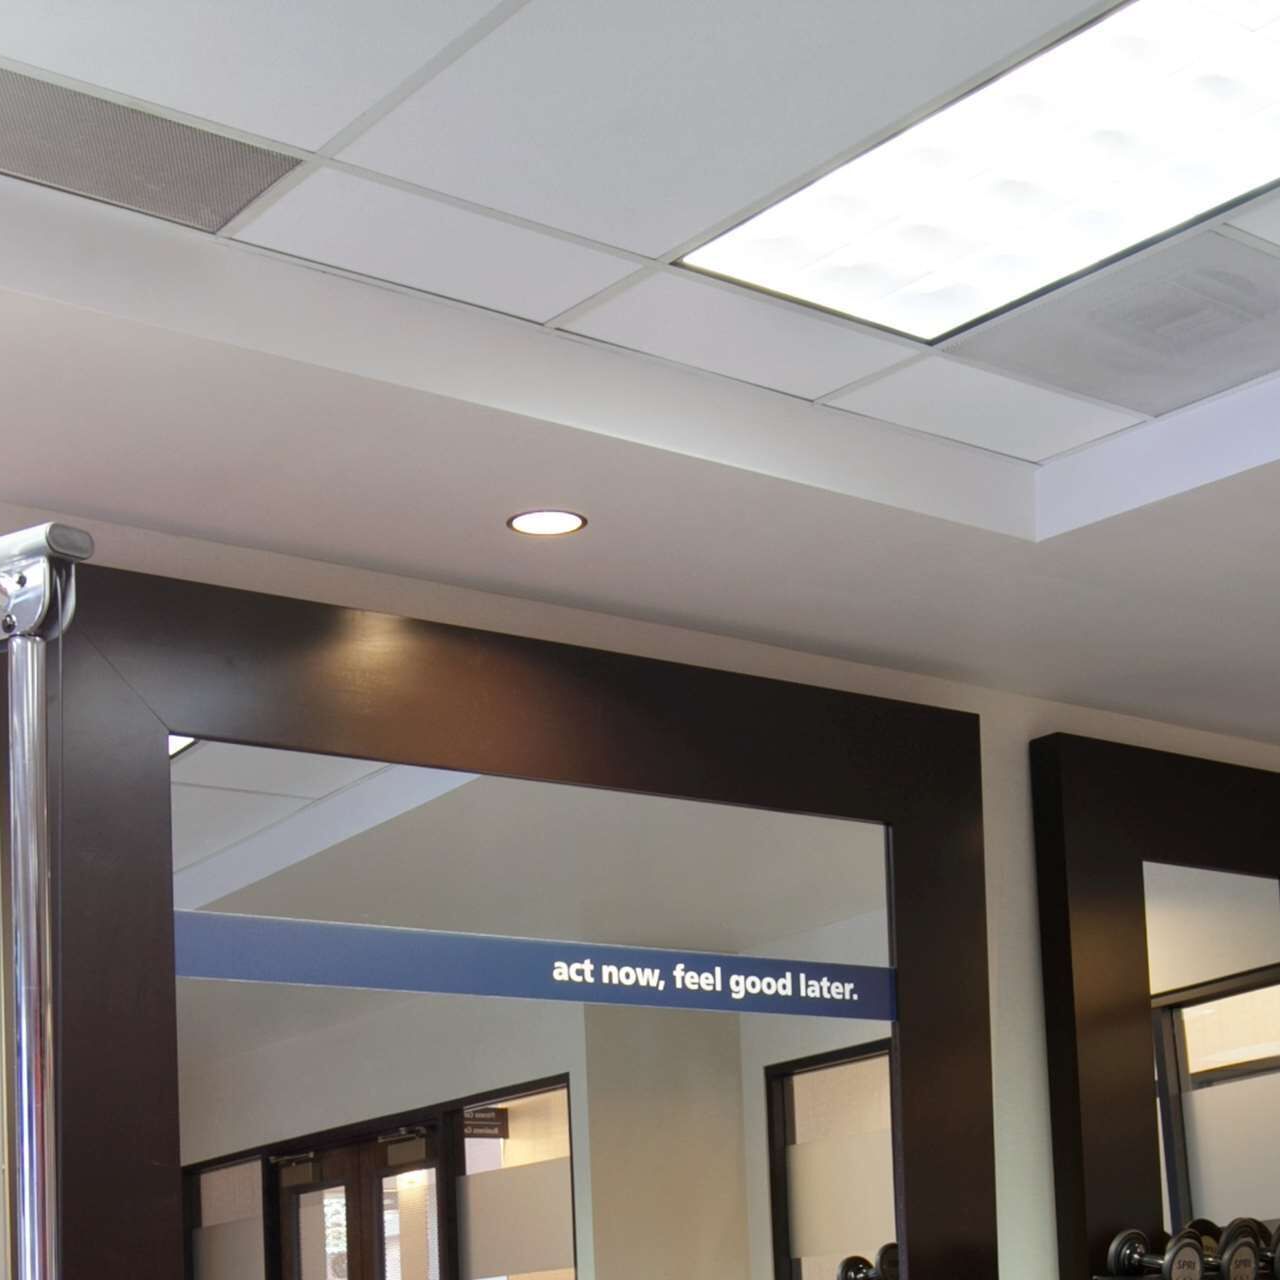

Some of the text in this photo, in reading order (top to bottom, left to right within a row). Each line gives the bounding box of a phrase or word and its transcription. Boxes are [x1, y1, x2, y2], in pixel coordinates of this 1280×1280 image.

[552, 958, 859, 1000] act now, feel good later.
